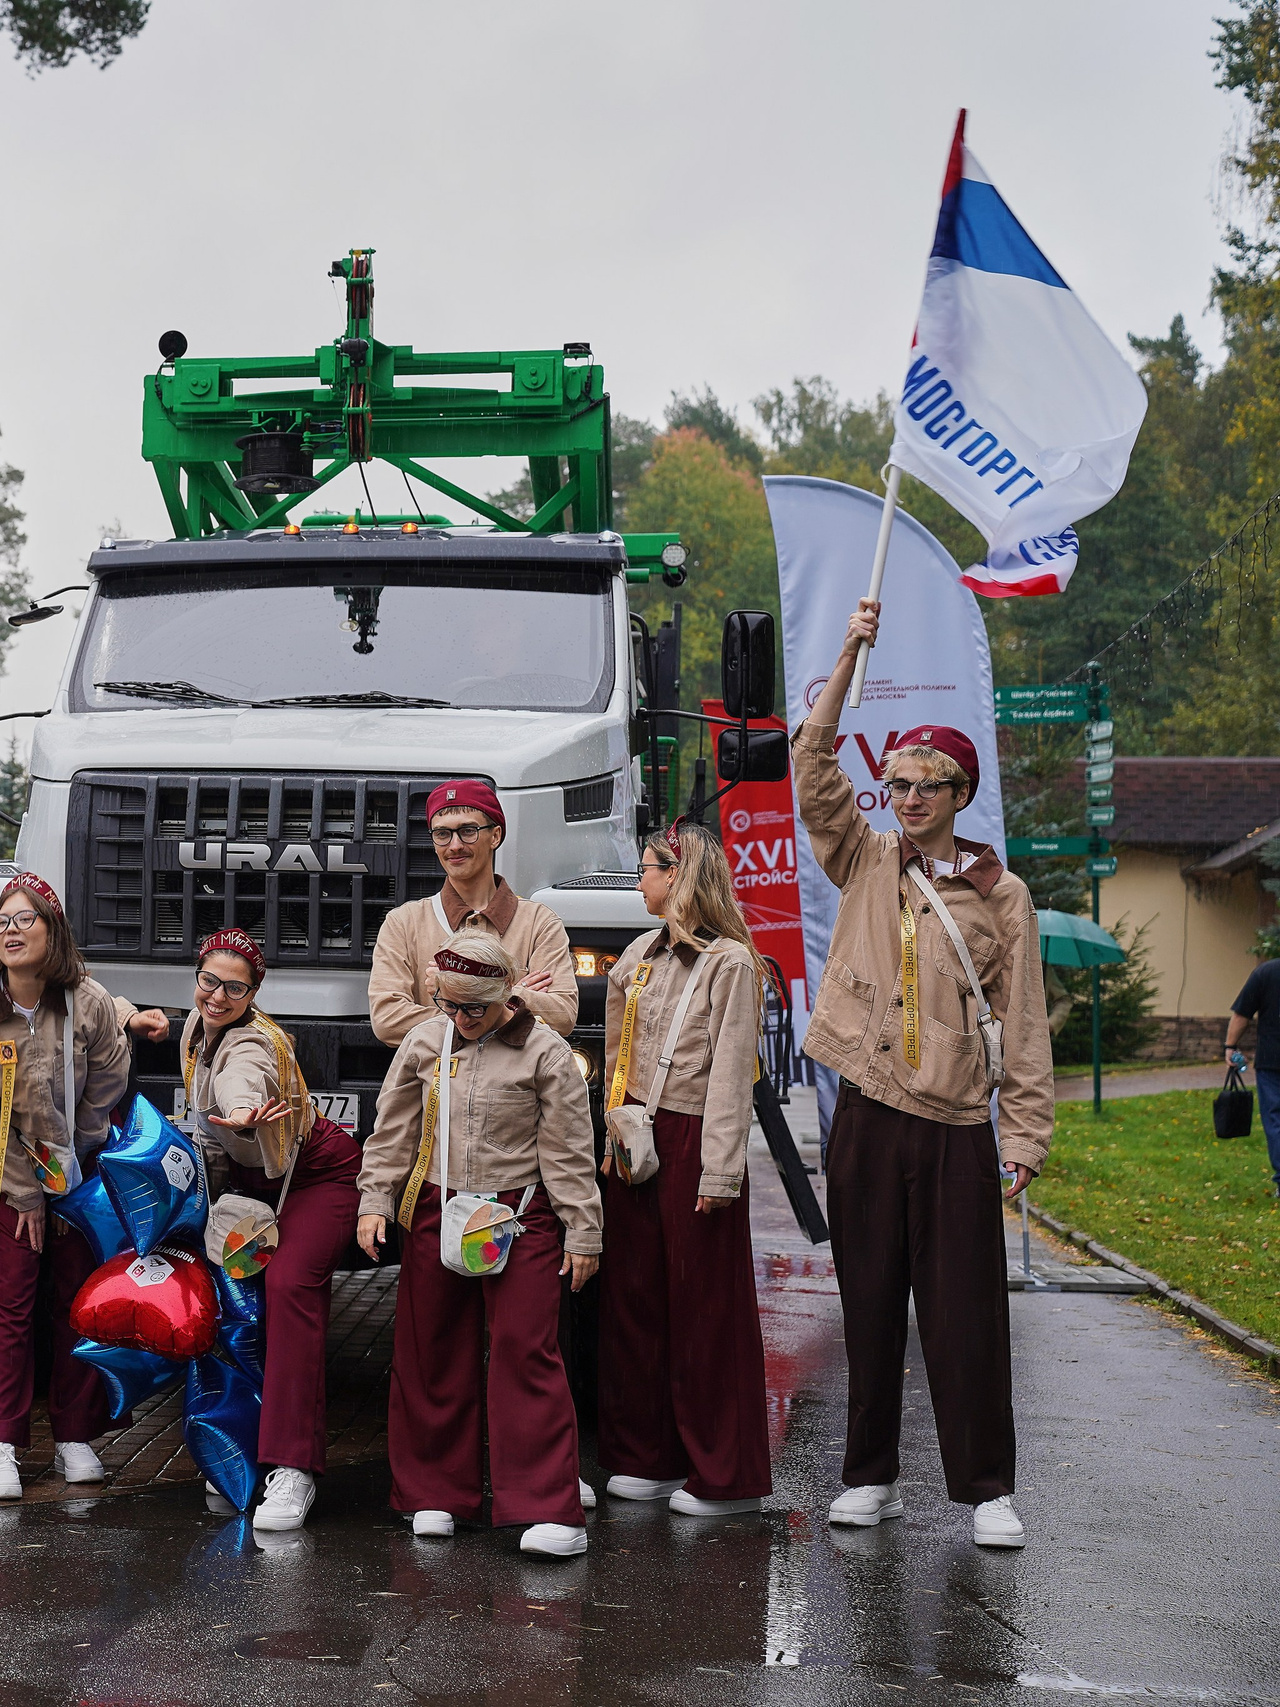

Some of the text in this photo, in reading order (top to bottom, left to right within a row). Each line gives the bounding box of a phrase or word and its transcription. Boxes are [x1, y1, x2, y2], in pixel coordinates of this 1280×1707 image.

[179, 842, 368, 872] URAL
[902, 907, 914, 977] МОСГОРГЕОТРЕСТ
[621, 986, 640, 1058] МОСГОРГЕОТРЕСТ
[906, 984, 916, 1060] МОСГОРГЕОТРЕСТ
[1, 1068, 12, 1141] МОСГОРГЕОТРЕСТ
[400, 1155, 428, 1226] МОСГОРГЕОТРЕСТ
